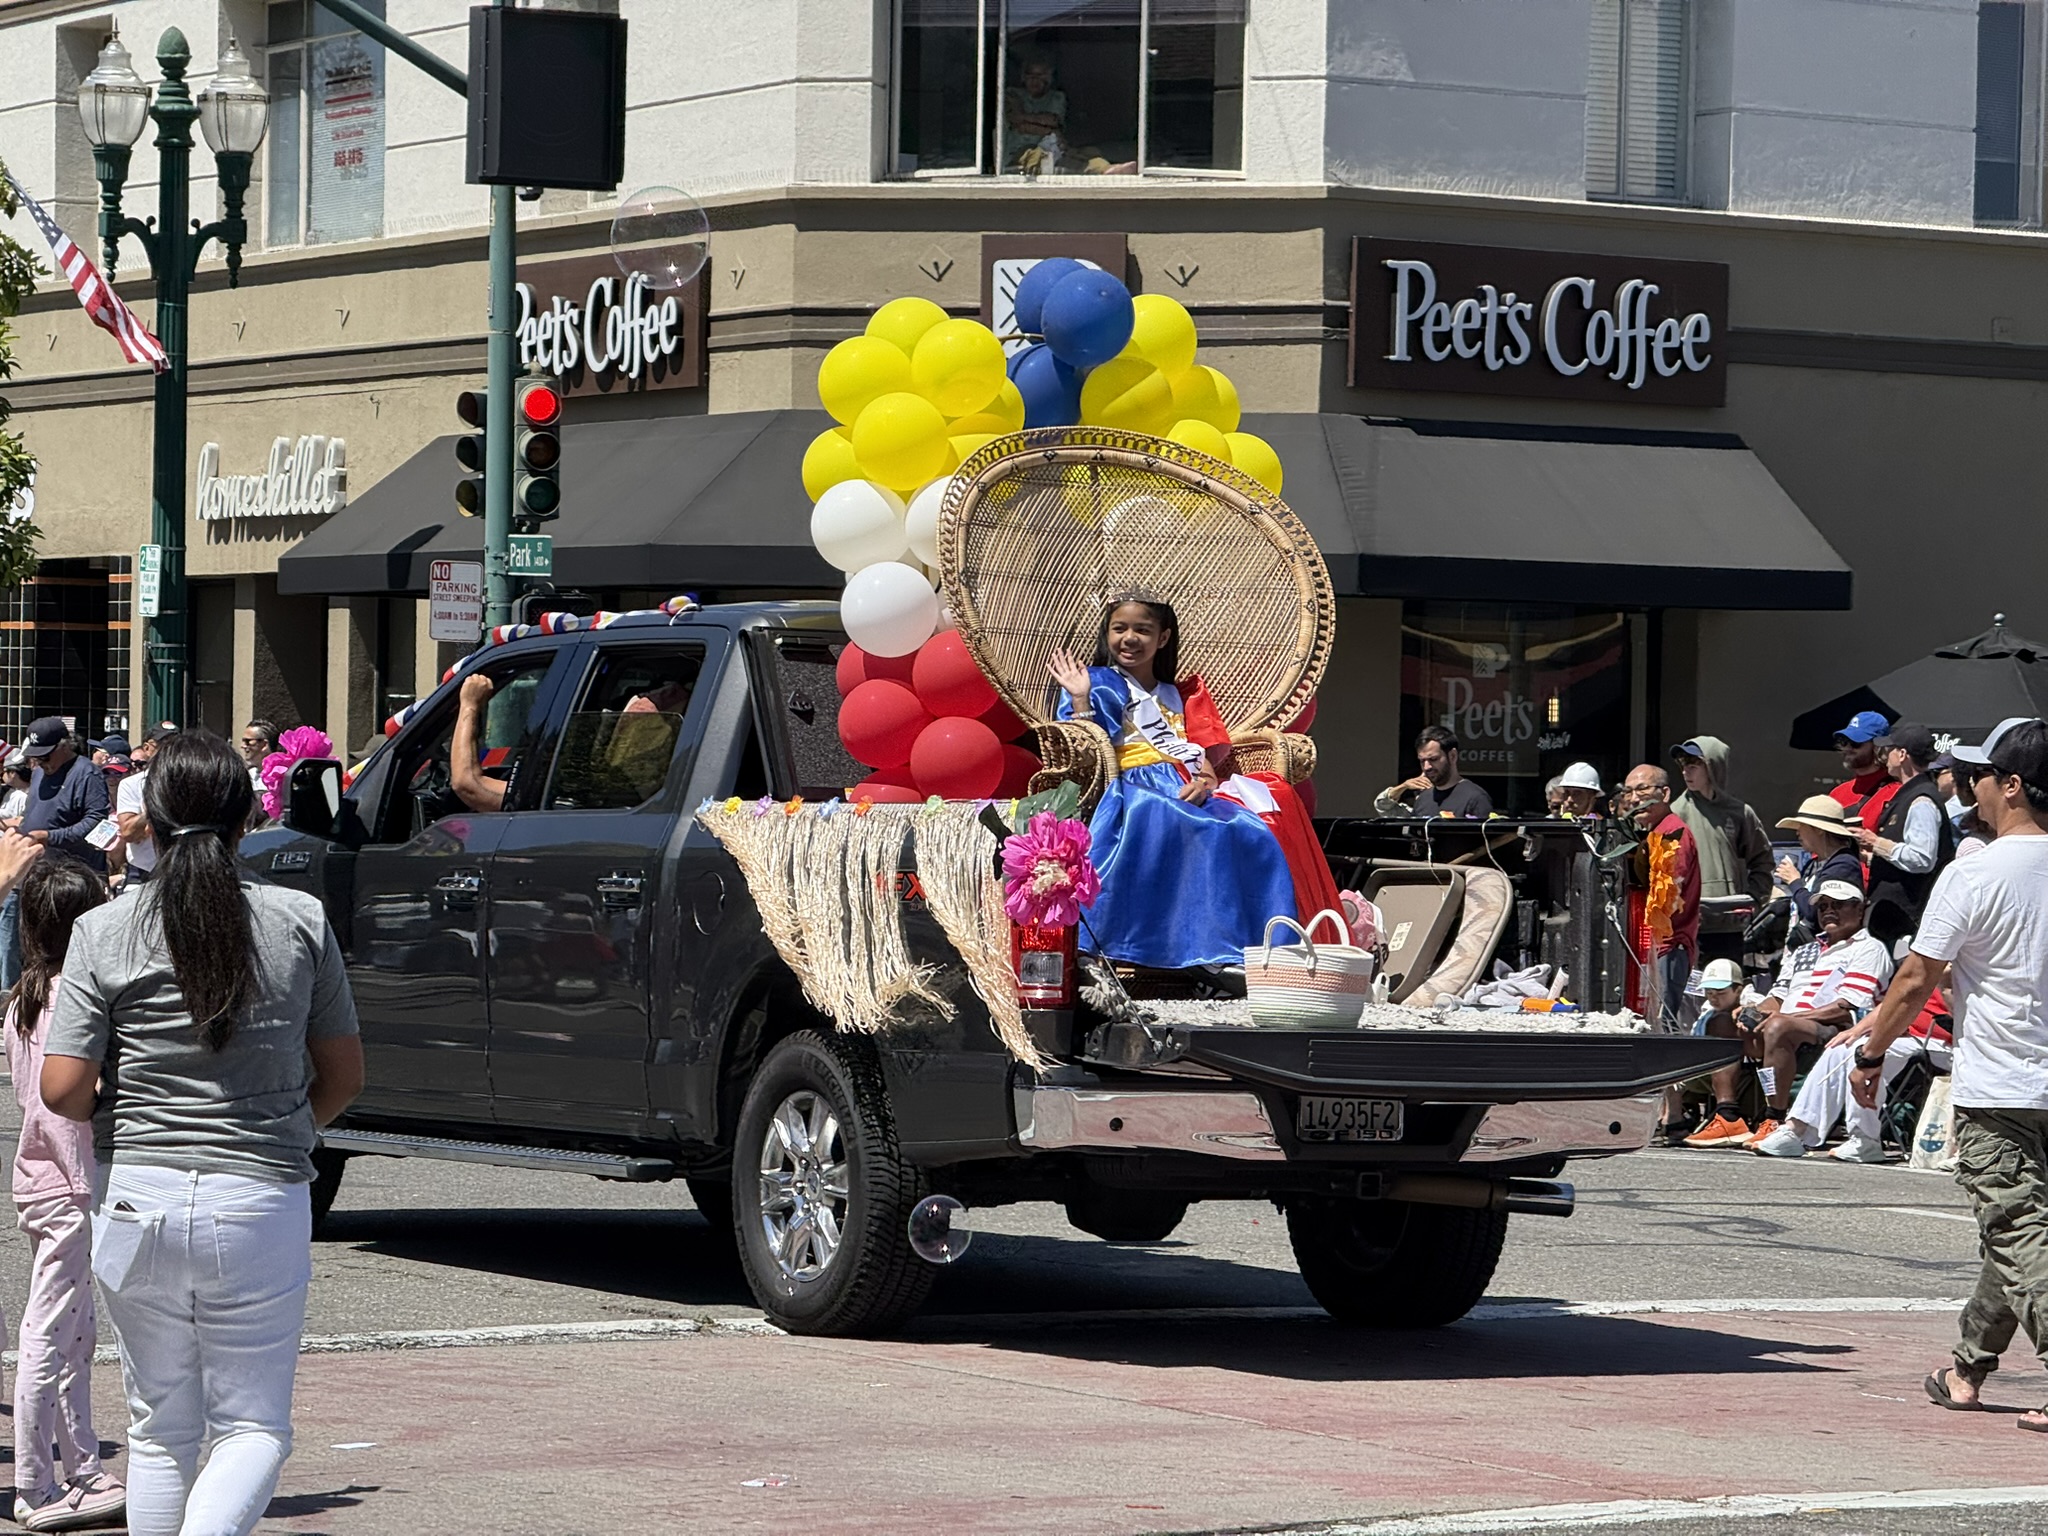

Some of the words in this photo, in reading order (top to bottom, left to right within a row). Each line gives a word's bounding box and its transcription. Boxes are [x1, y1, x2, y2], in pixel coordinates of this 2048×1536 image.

[584, 271, 678, 379] Coffee
[1383, 258, 1532, 371] Peet's
[1541, 276, 1712, 389] Coffee
[196, 434, 347, 520] homeskillet
[509, 543, 531, 567] Park
[537, 542, 543, 552] ST
[141, 550, 146, 567] 2
[433, 563, 449, 579] NO
[433, 593, 451, 602] STREET
[452, 594, 481, 602] SWEEPING
[436, 582, 477, 593] PARKING
[1441, 677, 1534, 745] Peet's
[1931, 733, 1961, 754] offee
[1460, 751, 1514, 762] COFFEE
[1304, 1101, 1395, 1130] 14935F2
